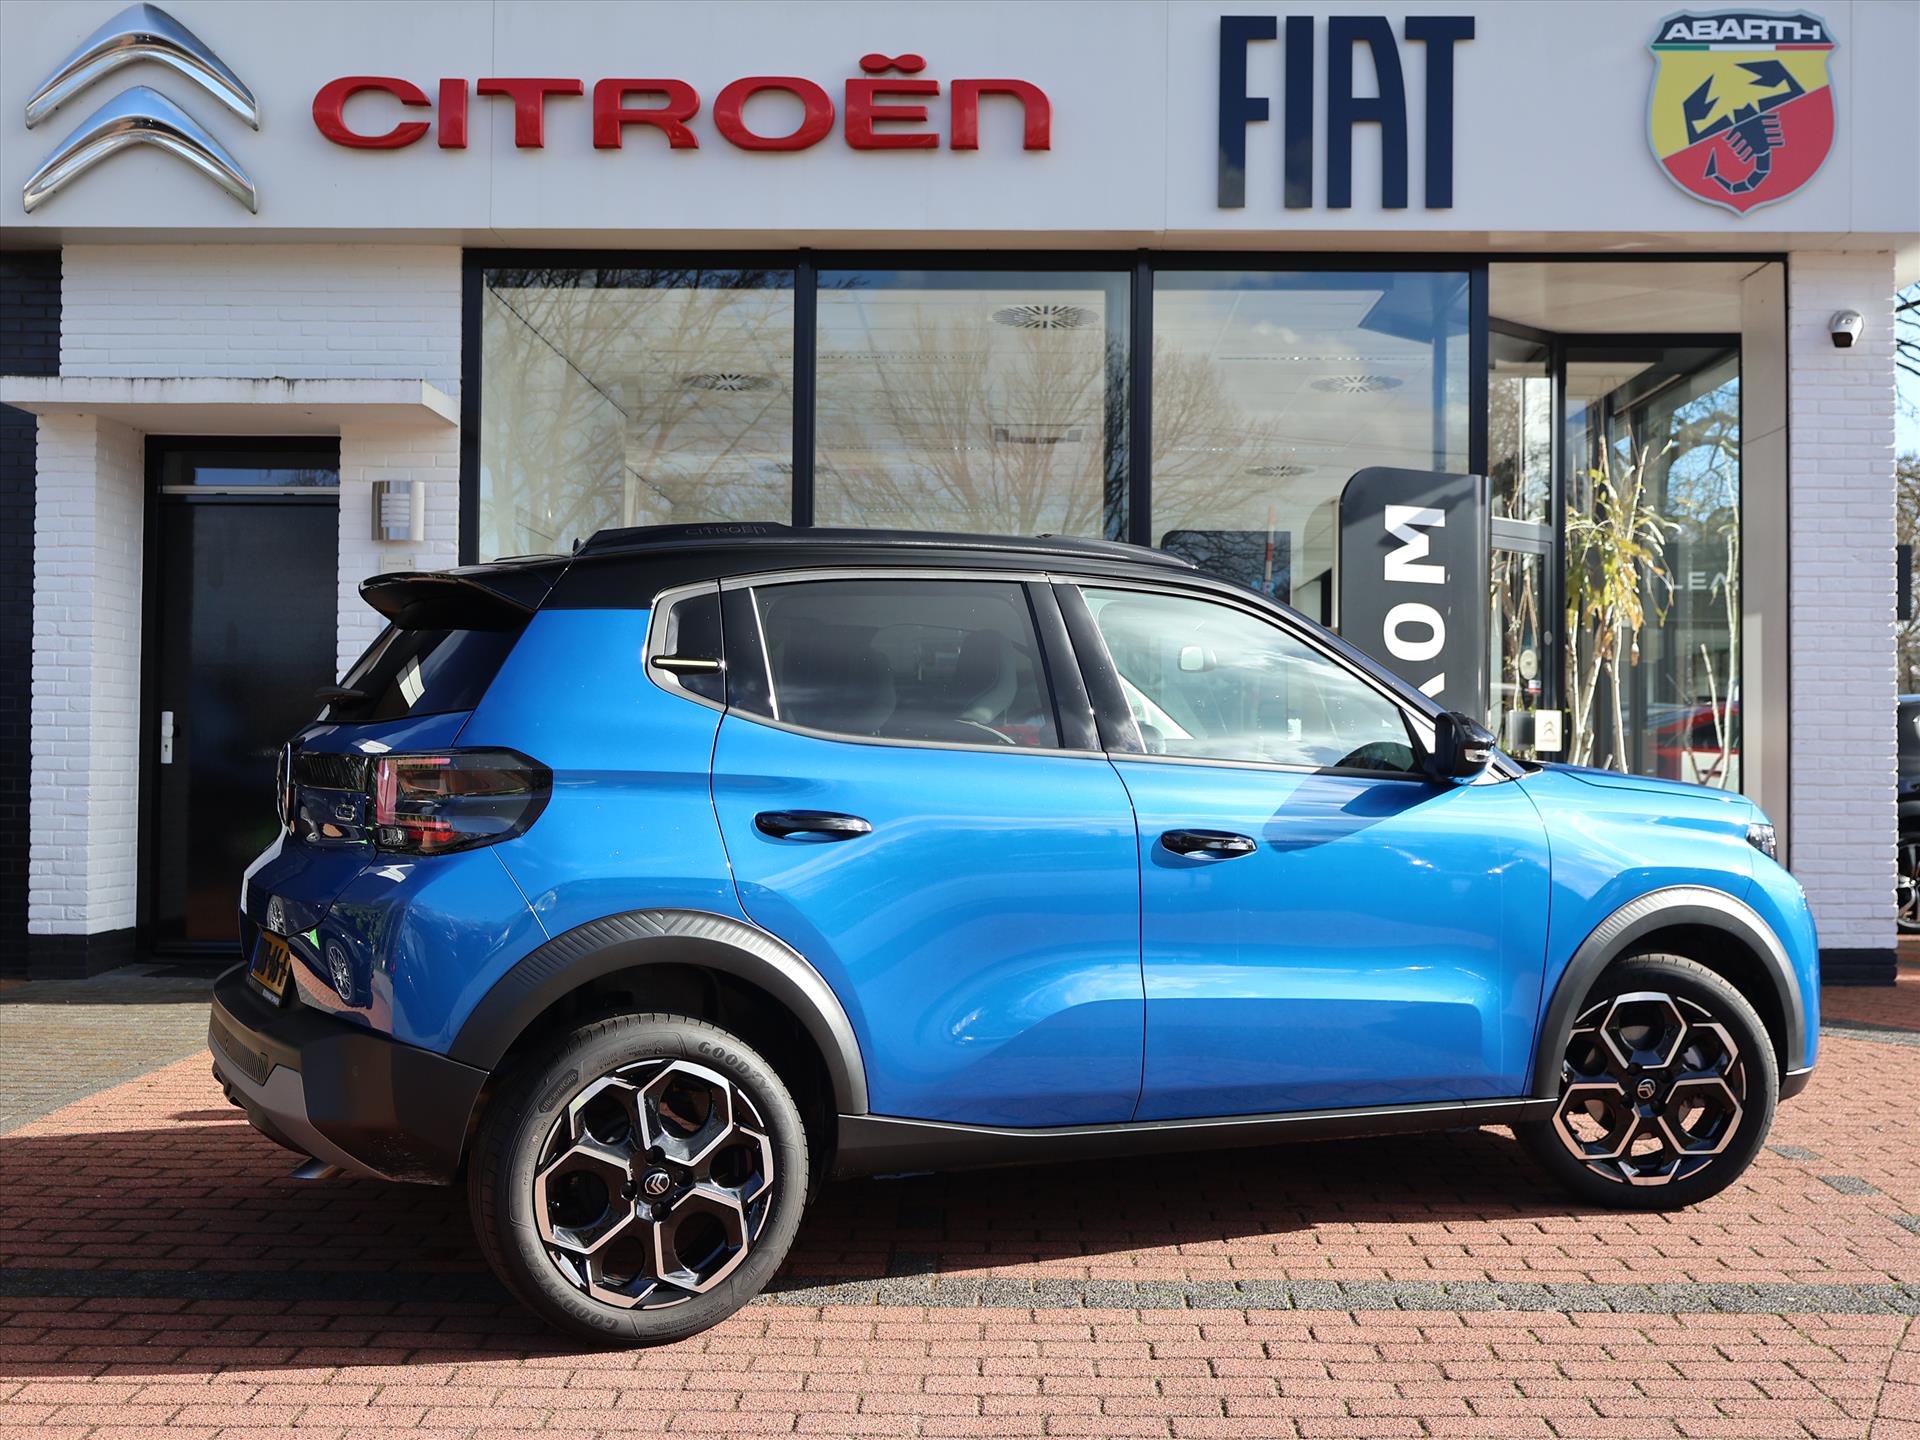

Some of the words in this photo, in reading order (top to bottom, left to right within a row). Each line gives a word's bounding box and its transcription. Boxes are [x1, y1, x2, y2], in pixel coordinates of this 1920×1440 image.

[1218, 15, 1475, 209] FIAT
[1664, 18, 1821, 41] ABARTH
[1383, 504, 1447, 699] OM
